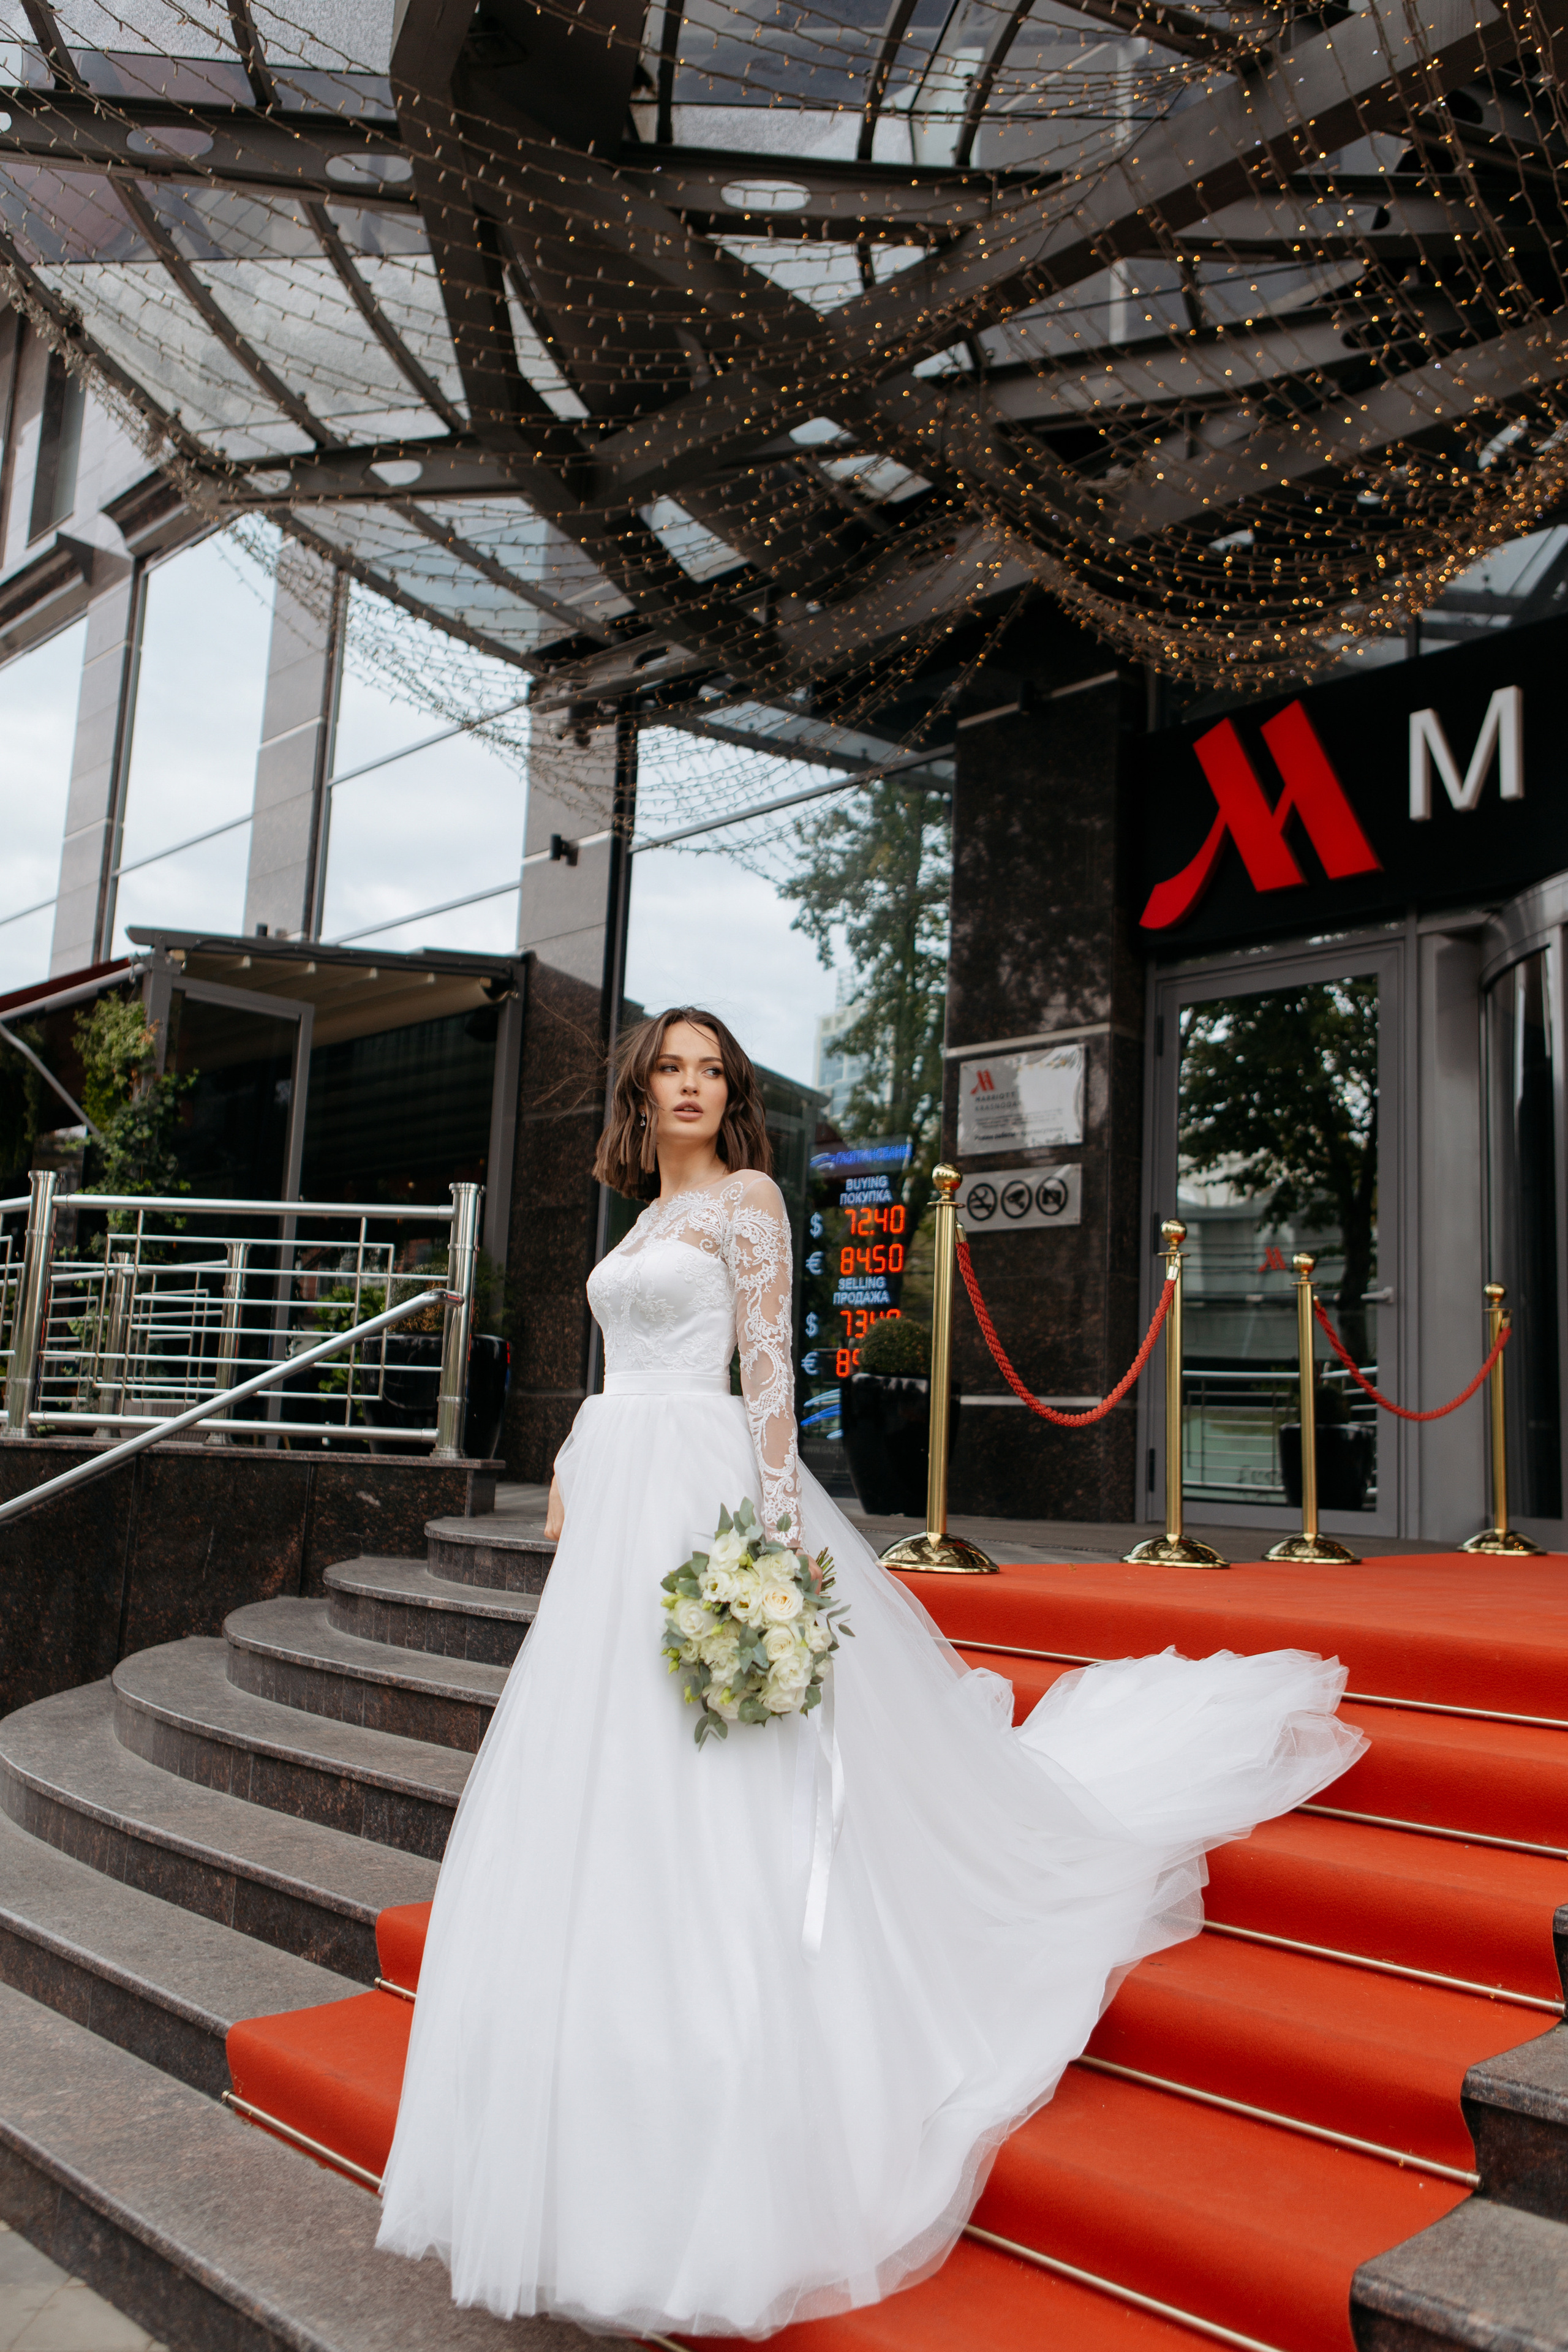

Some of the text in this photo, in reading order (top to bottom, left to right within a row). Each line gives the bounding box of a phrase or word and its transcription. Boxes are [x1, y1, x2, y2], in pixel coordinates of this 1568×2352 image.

[975, 1091, 1016, 1102] MARRIOTT
[845, 1175, 889, 1193] BUYING
[840, 1189, 894, 1207] ПОКУПКА
[845, 1204, 905, 1237] 72.40
[840, 1243, 903, 1275] 84.50
[838, 1276, 887, 1291] SELLING
[833, 1290, 891, 1306] ПРОДАЖА
